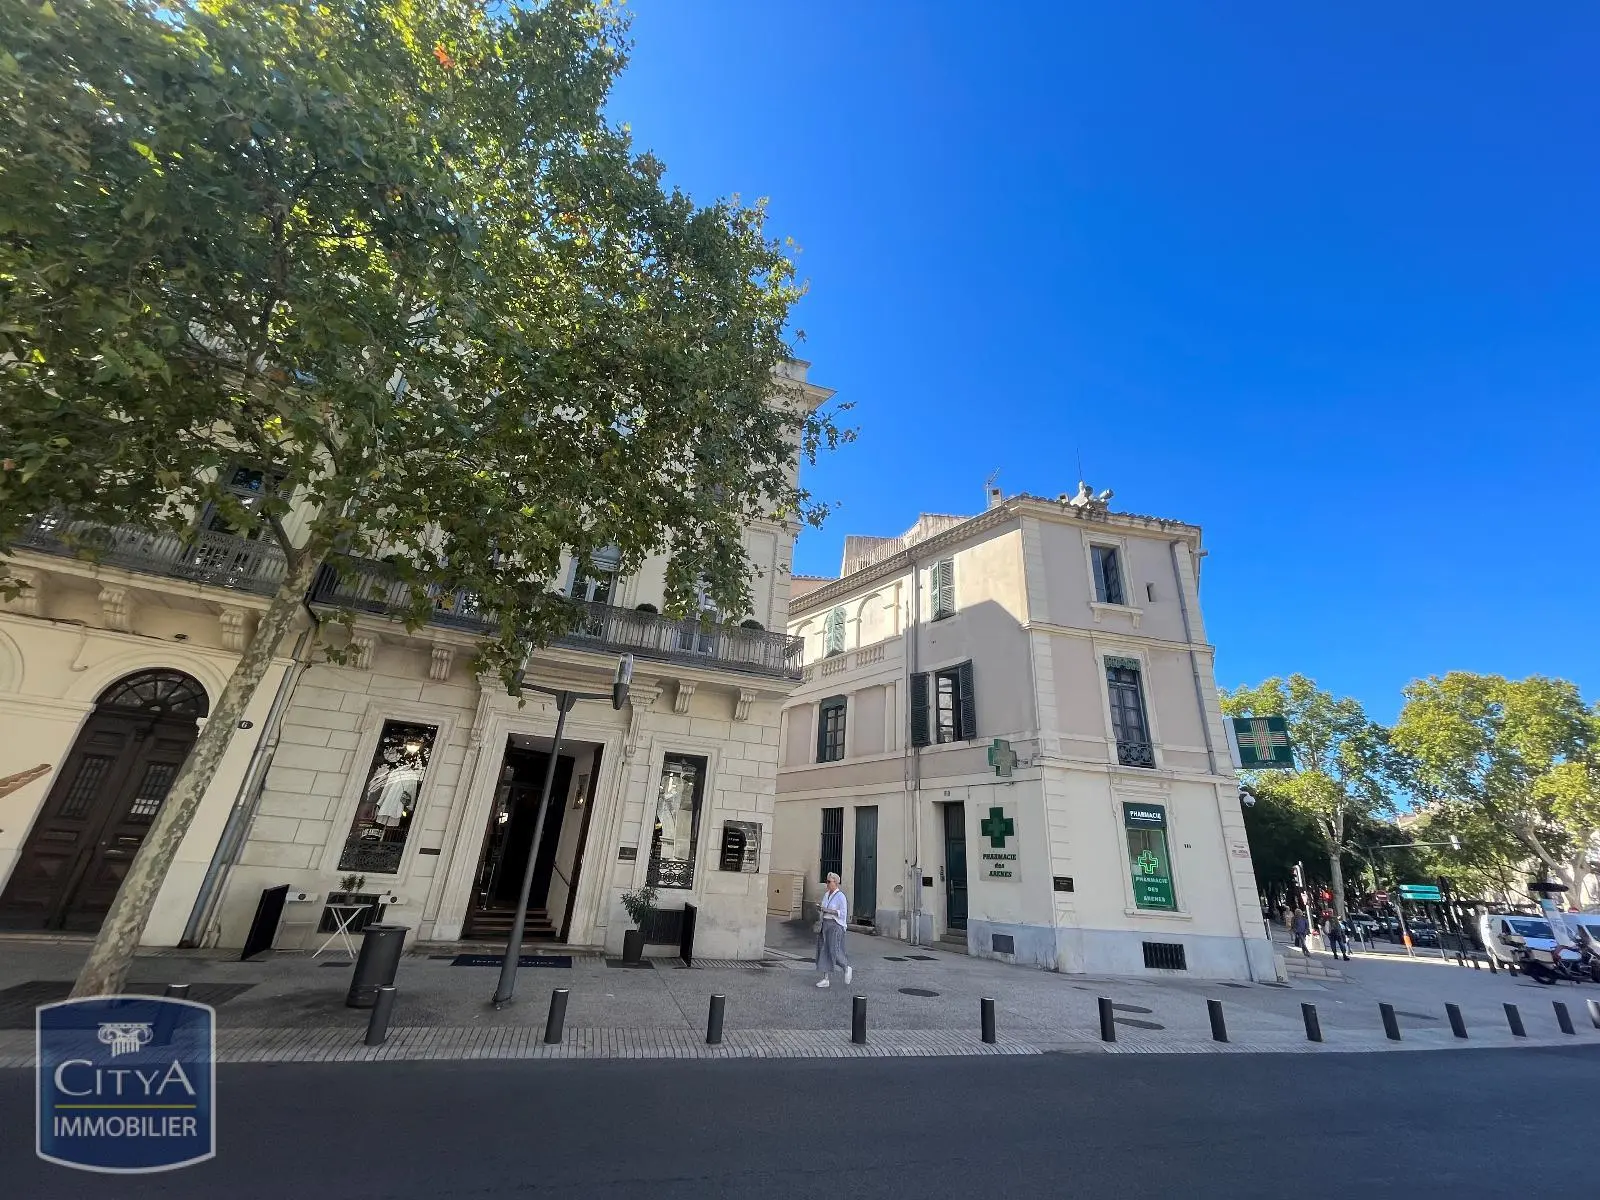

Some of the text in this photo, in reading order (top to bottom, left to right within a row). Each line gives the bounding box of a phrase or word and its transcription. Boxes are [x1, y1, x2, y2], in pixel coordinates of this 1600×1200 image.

[1129, 810, 1162, 820] PHARMACIE
[982, 853, 1017, 861] PHARMACIE
[1135, 876, 1169, 884] PHARMACIE
